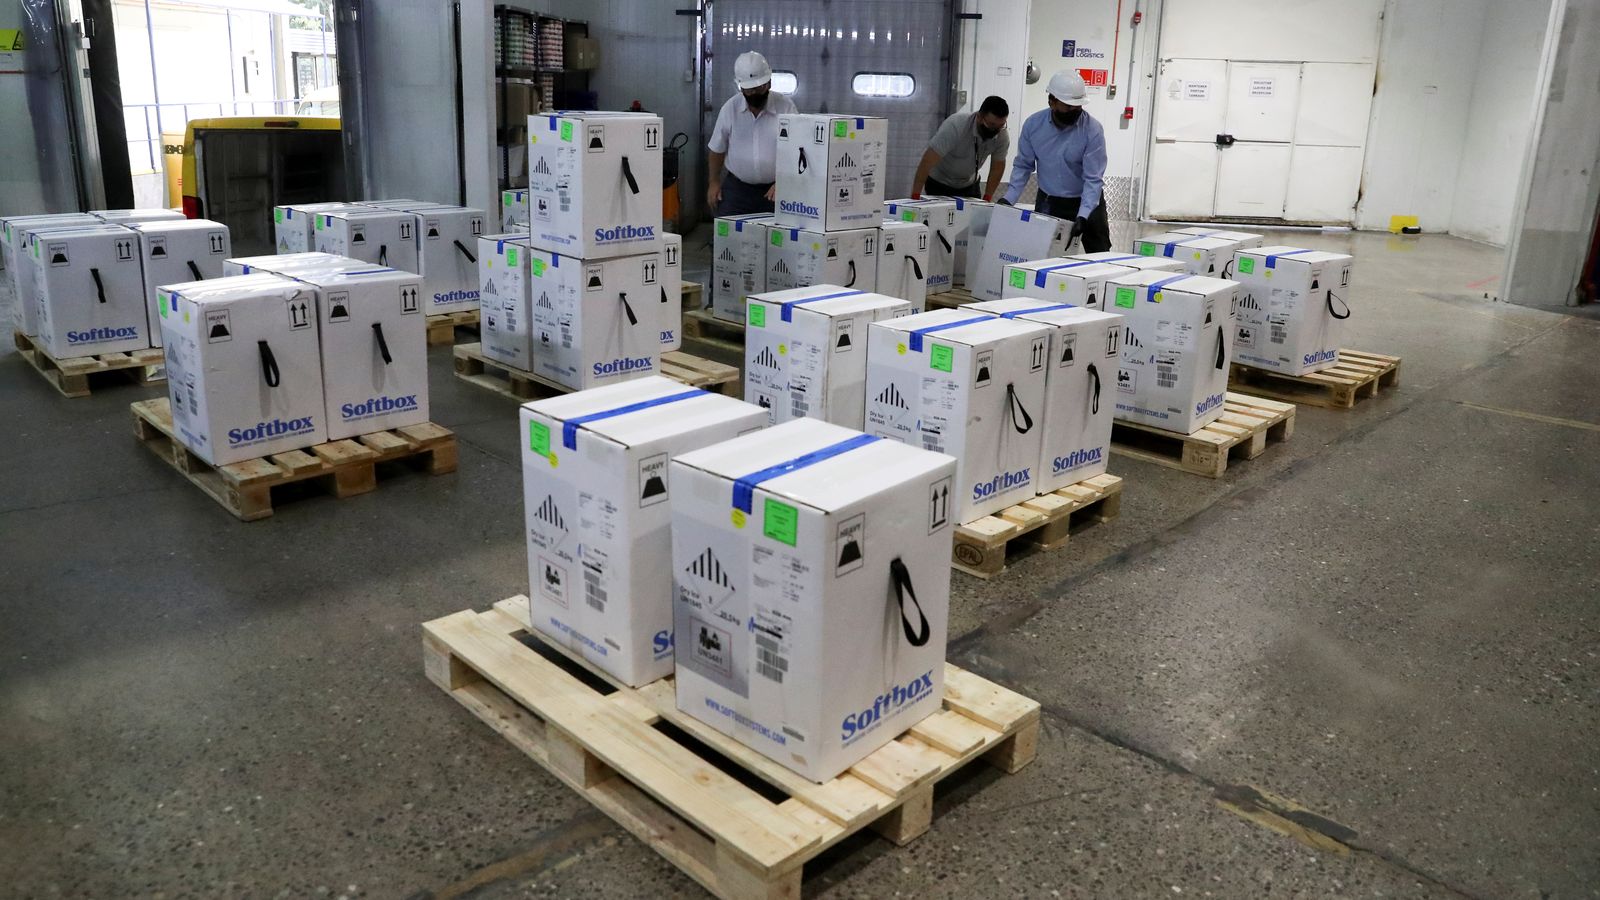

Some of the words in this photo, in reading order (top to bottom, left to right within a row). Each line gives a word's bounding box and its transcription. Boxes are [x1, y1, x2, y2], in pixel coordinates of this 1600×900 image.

[780, 200, 819, 217] Softbox
[595, 225, 654, 242] Softbox
[999, 252, 1019, 263] MEDIUM
[434, 290, 480, 304] Softbox
[208, 314, 226, 322] HEAVY
[67, 326, 137, 343] Softbox
[594, 356, 652, 376] Softbox
[978, 356, 991, 364] HEAVY
[1304, 349, 1336, 366] Softbox
[342, 394, 418, 418] Softbox
[1196, 392, 1224, 416] Softbox
[228, 416, 313, 444] Softbox
[642, 462, 664, 473] HEAVY
[1053, 447, 1103, 473] Softbox
[972, 468, 1031, 500] Softbox
[840, 523, 861, 537] HEAVY
[958, 549, 978, 564] EPAL
[842, 668, 935, 741] Softbox
[704, 697, 786, 746] WWW.SOFTBOXSYSTEMS.COM
